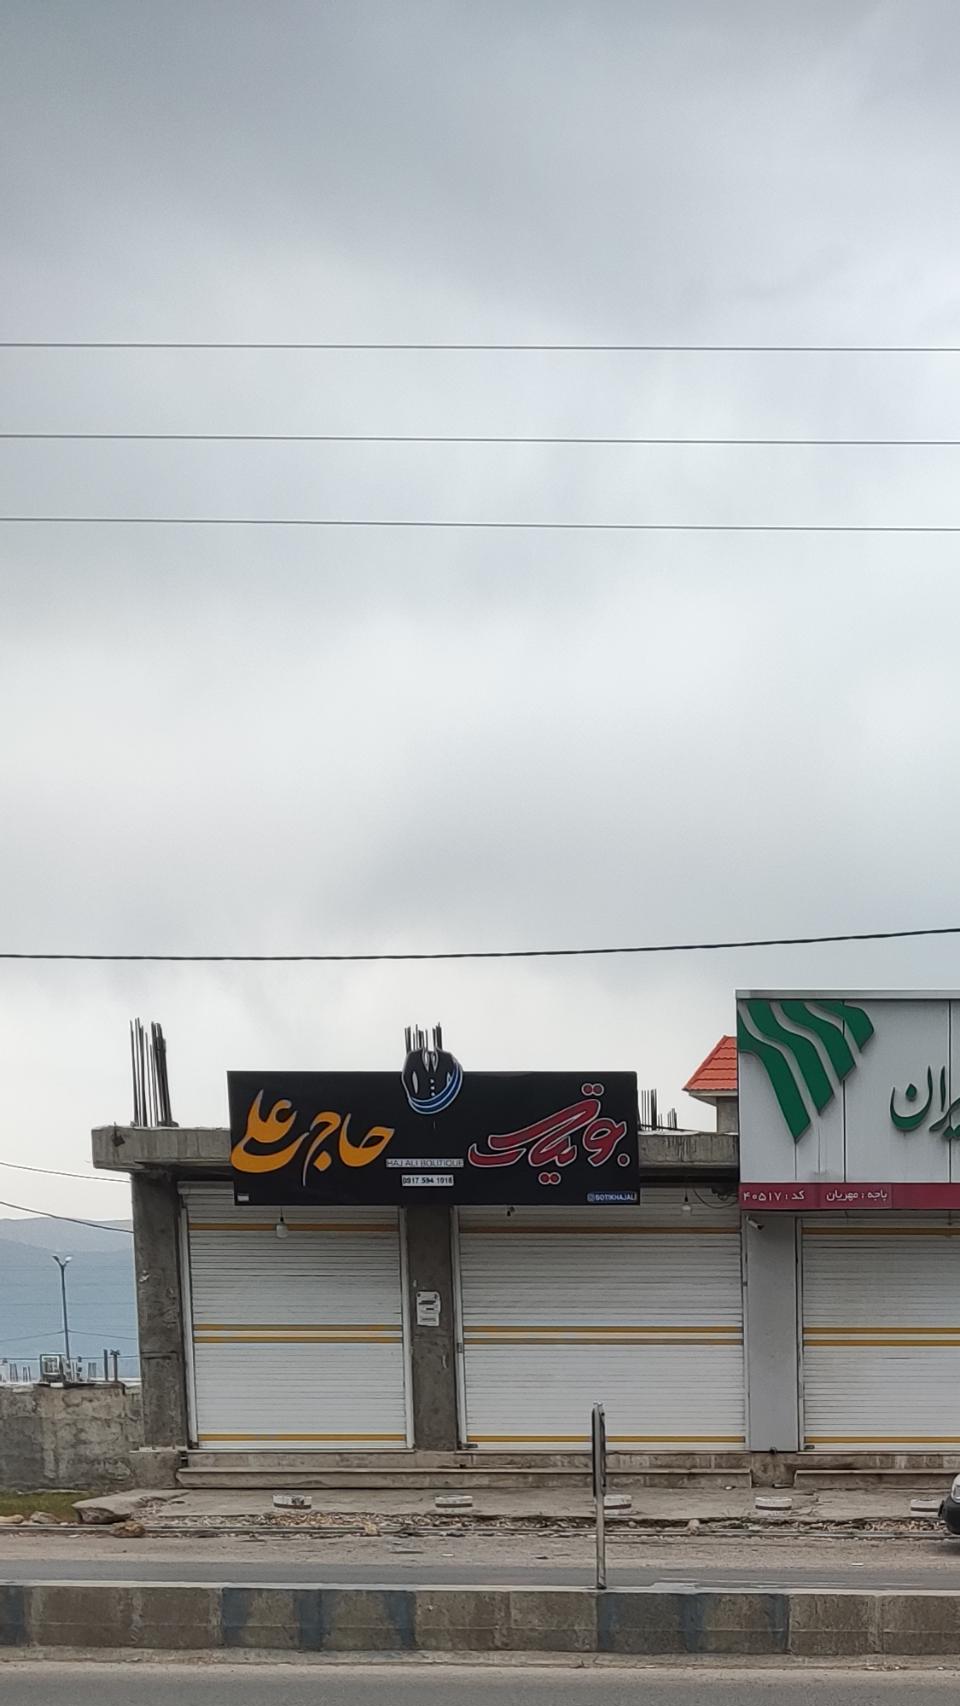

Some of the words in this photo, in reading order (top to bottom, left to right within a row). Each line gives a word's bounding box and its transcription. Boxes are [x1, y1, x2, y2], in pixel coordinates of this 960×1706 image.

[230, 1089, 310, 1174] علی
[302, 1111, 395, 1187] حاج
[468, 1083, 631, 1185] بوتیک
[743, 1191, 781, 1201] ۴۰۵۱۷
[792, 1188, 805, 1200] کد
[867, 1189, 888, 1201] باجه
